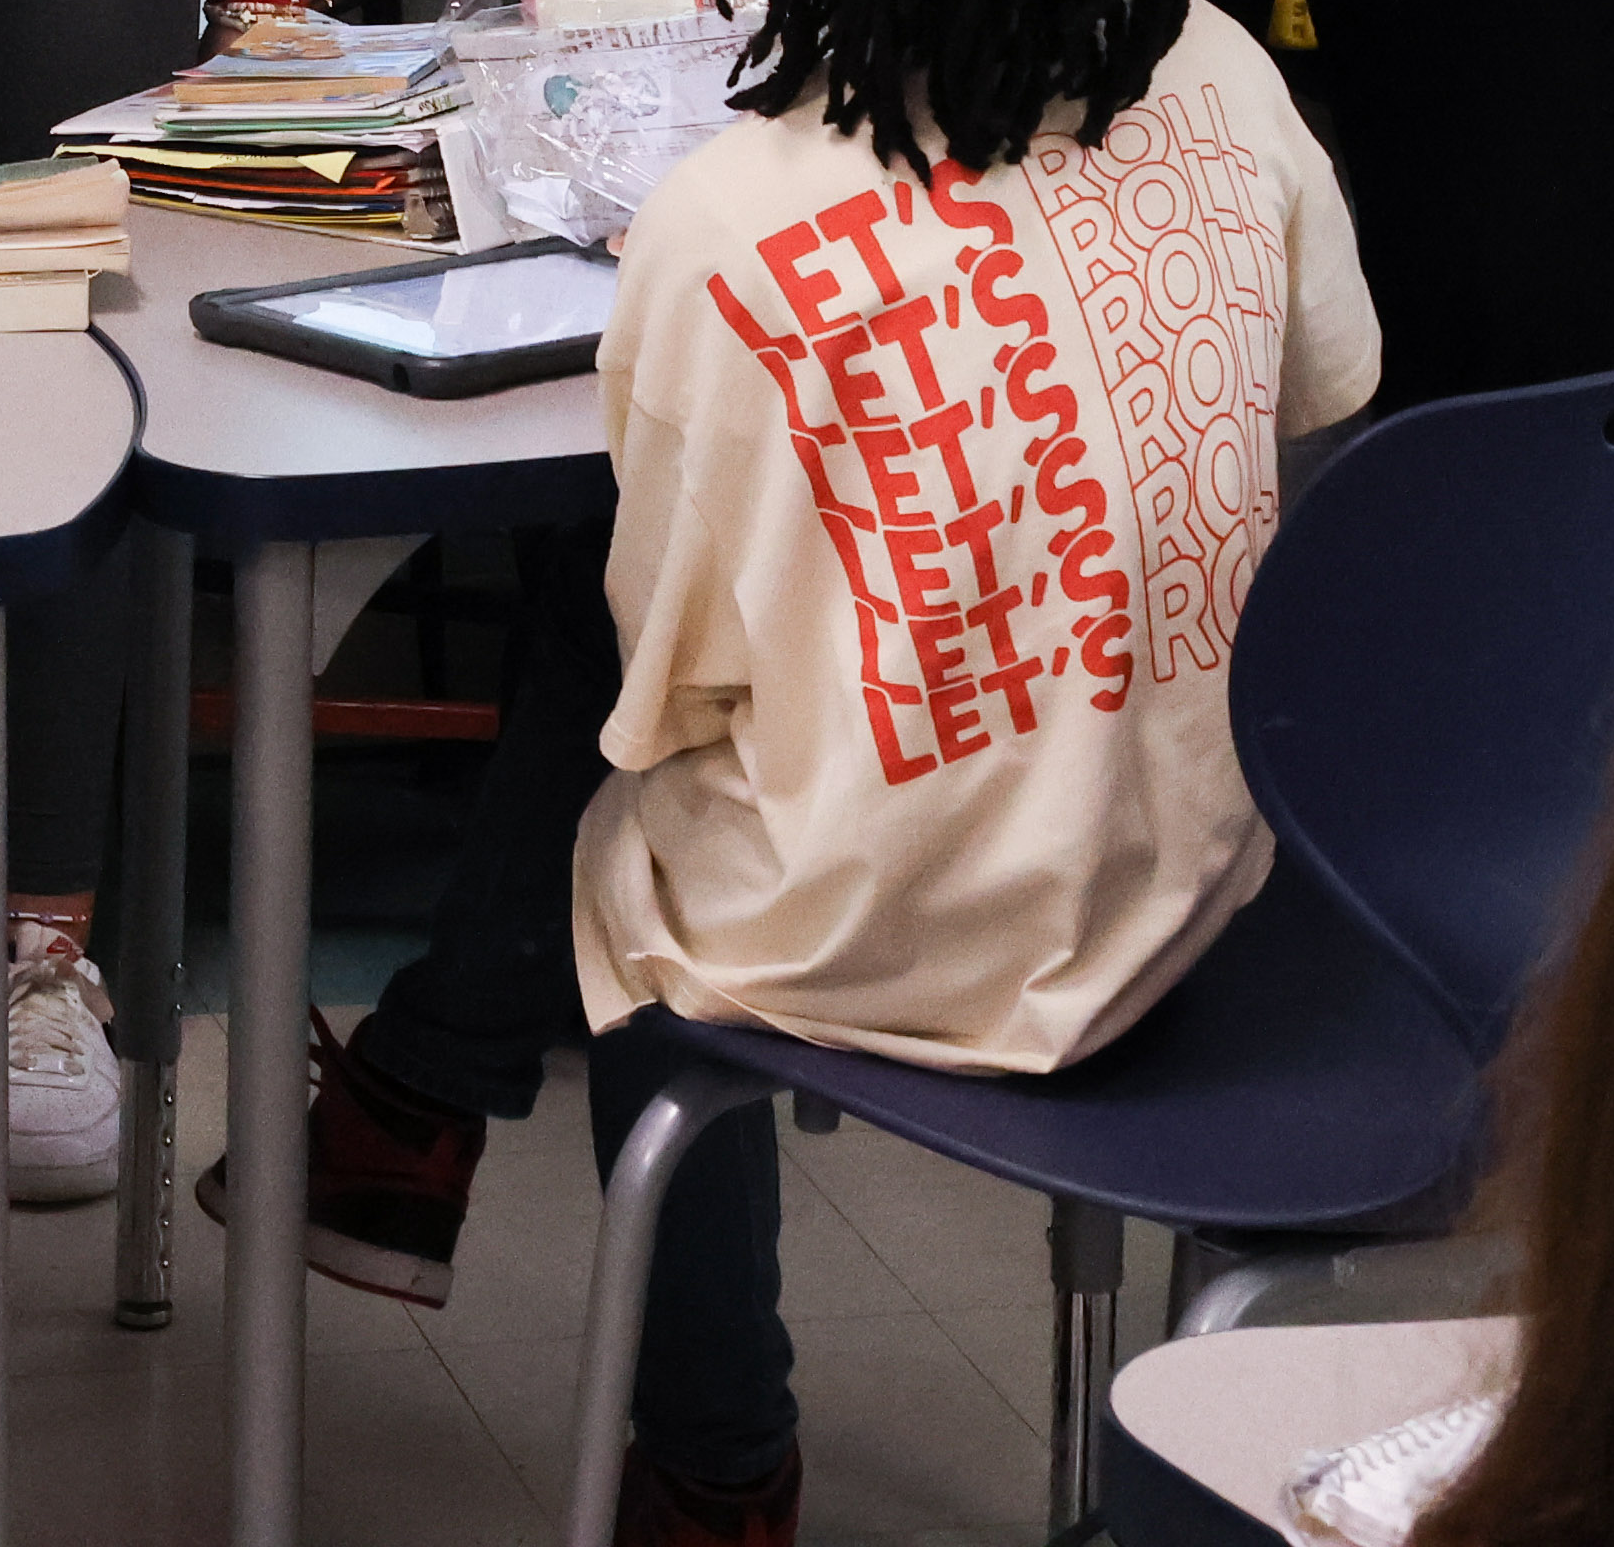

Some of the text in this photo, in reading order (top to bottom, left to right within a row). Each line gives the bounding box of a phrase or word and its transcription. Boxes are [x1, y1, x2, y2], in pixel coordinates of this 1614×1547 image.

[706, 157, 1014, 359] LET'S
[755, 247, 1049, 448] LET'S
[791, 340, 1079, 533] LET'S
[818, 436, 1107, 625] LET'S
[853, 528, 1130, 705] LET'S
[861, 612, 1134, 787] LET'S
